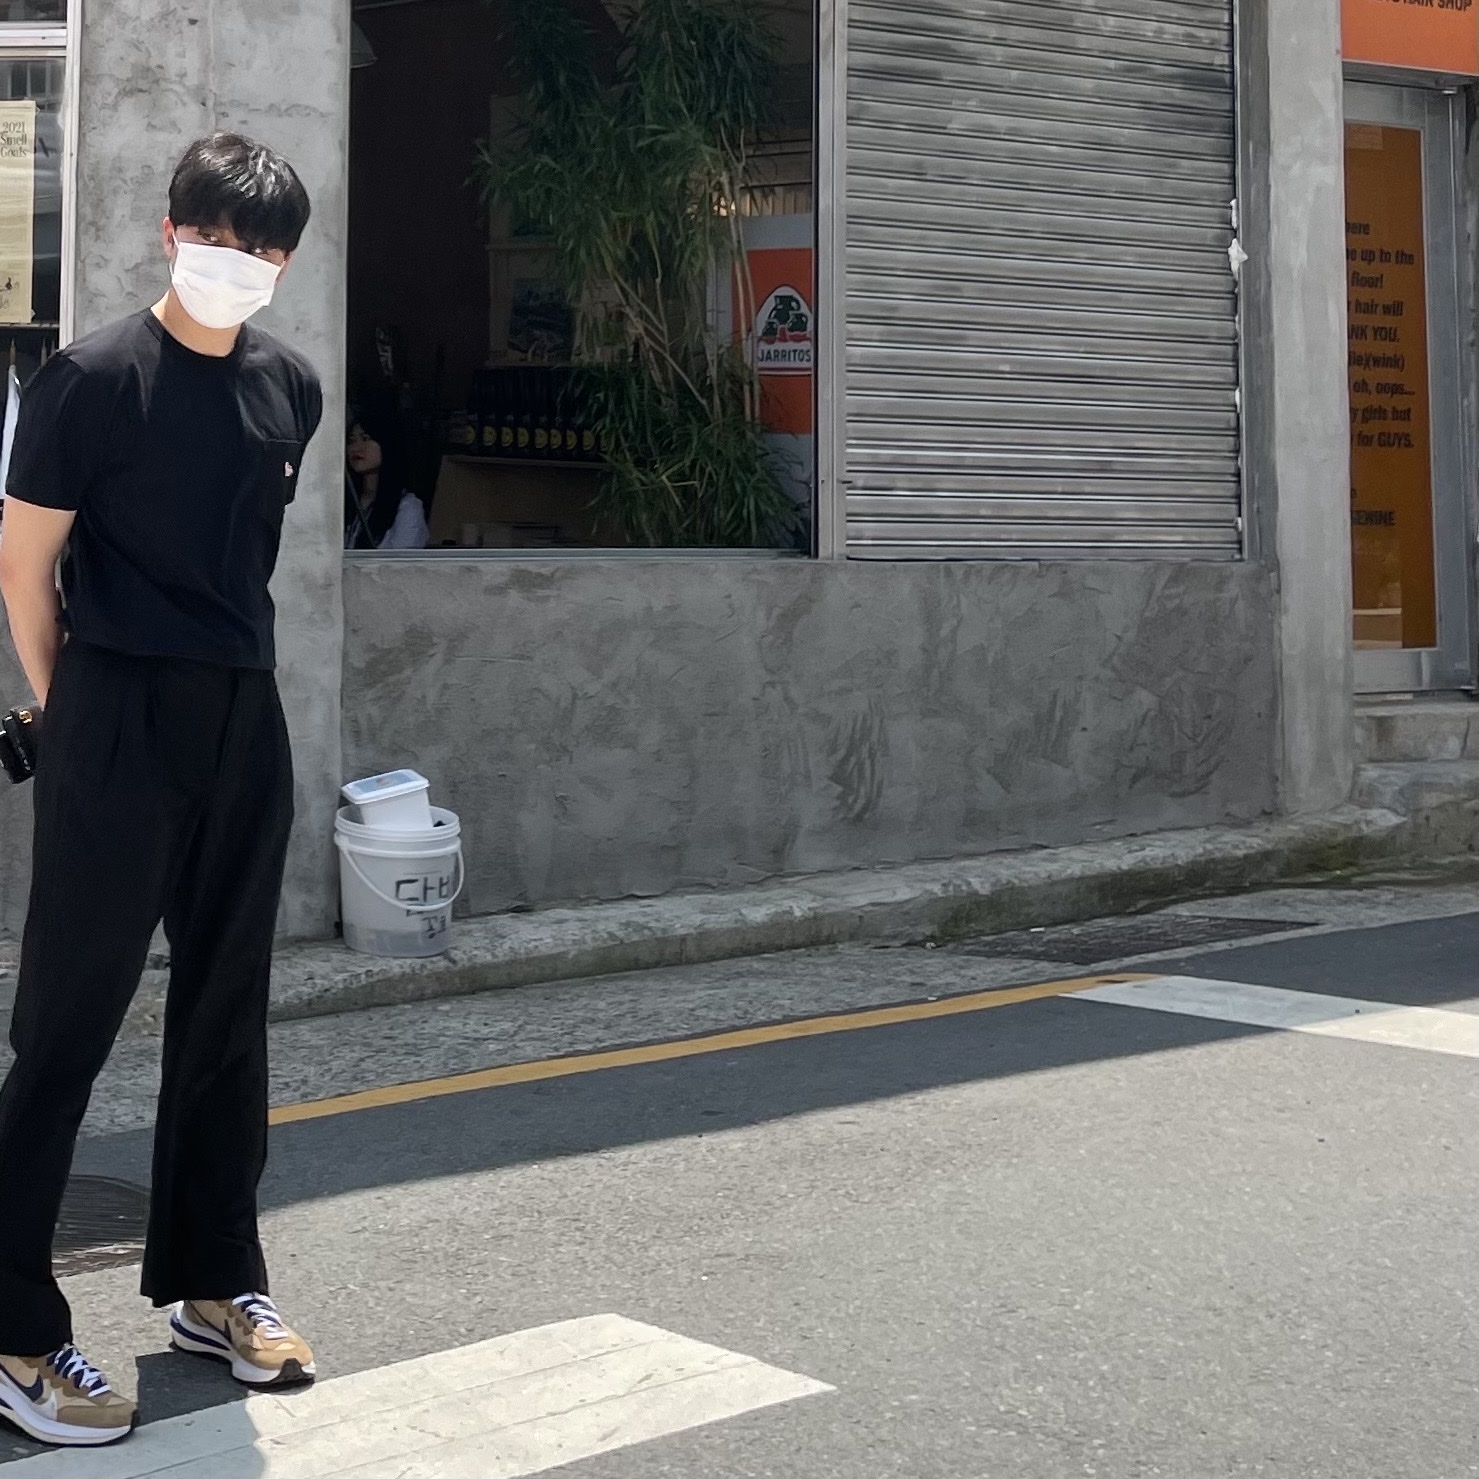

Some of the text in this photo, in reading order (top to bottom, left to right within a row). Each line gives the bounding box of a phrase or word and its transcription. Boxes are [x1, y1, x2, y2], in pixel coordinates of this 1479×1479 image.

[2, 121, 26, 134] 2021
[1395, 249, 1415, 265] the
[1354, 298, 1404, 316] hair will
[759, 348, 812, 362] JARRITOS
